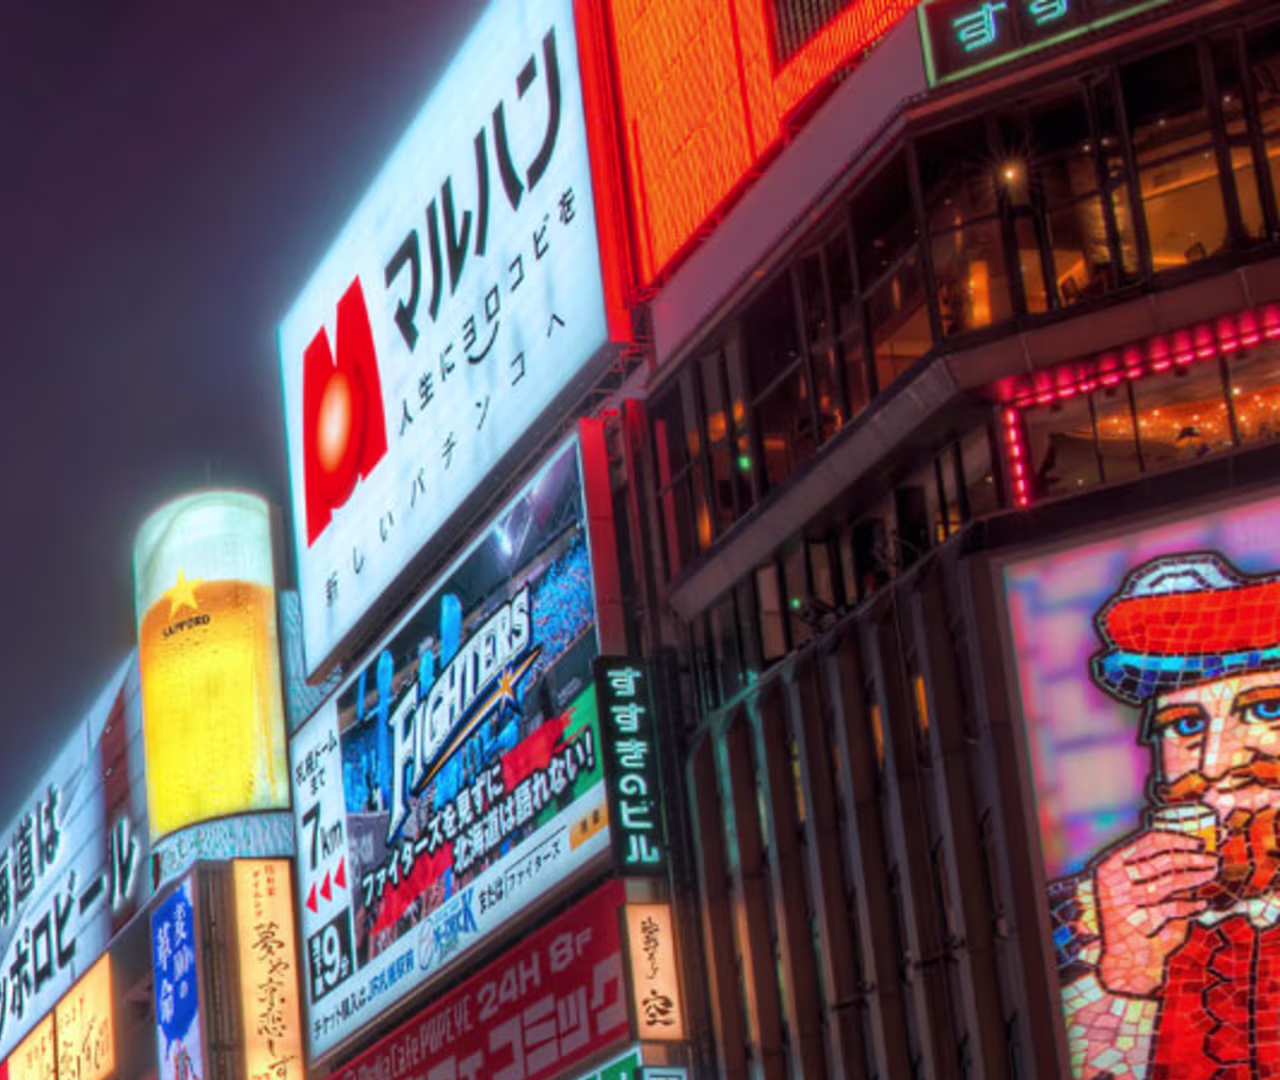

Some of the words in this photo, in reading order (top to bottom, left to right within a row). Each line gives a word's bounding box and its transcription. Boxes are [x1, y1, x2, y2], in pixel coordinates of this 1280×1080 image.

[384, 24, 564, 353] マルハン
[398, 186, 578, 438] 人生にヨロコビを
[361, 764, 505, 908] ファイターズを見ずに
[387, 581, 533, 843] FIGHTERS
[476, 953, 539, 1020] 24H
[548, 926, 593, 976] 8F
